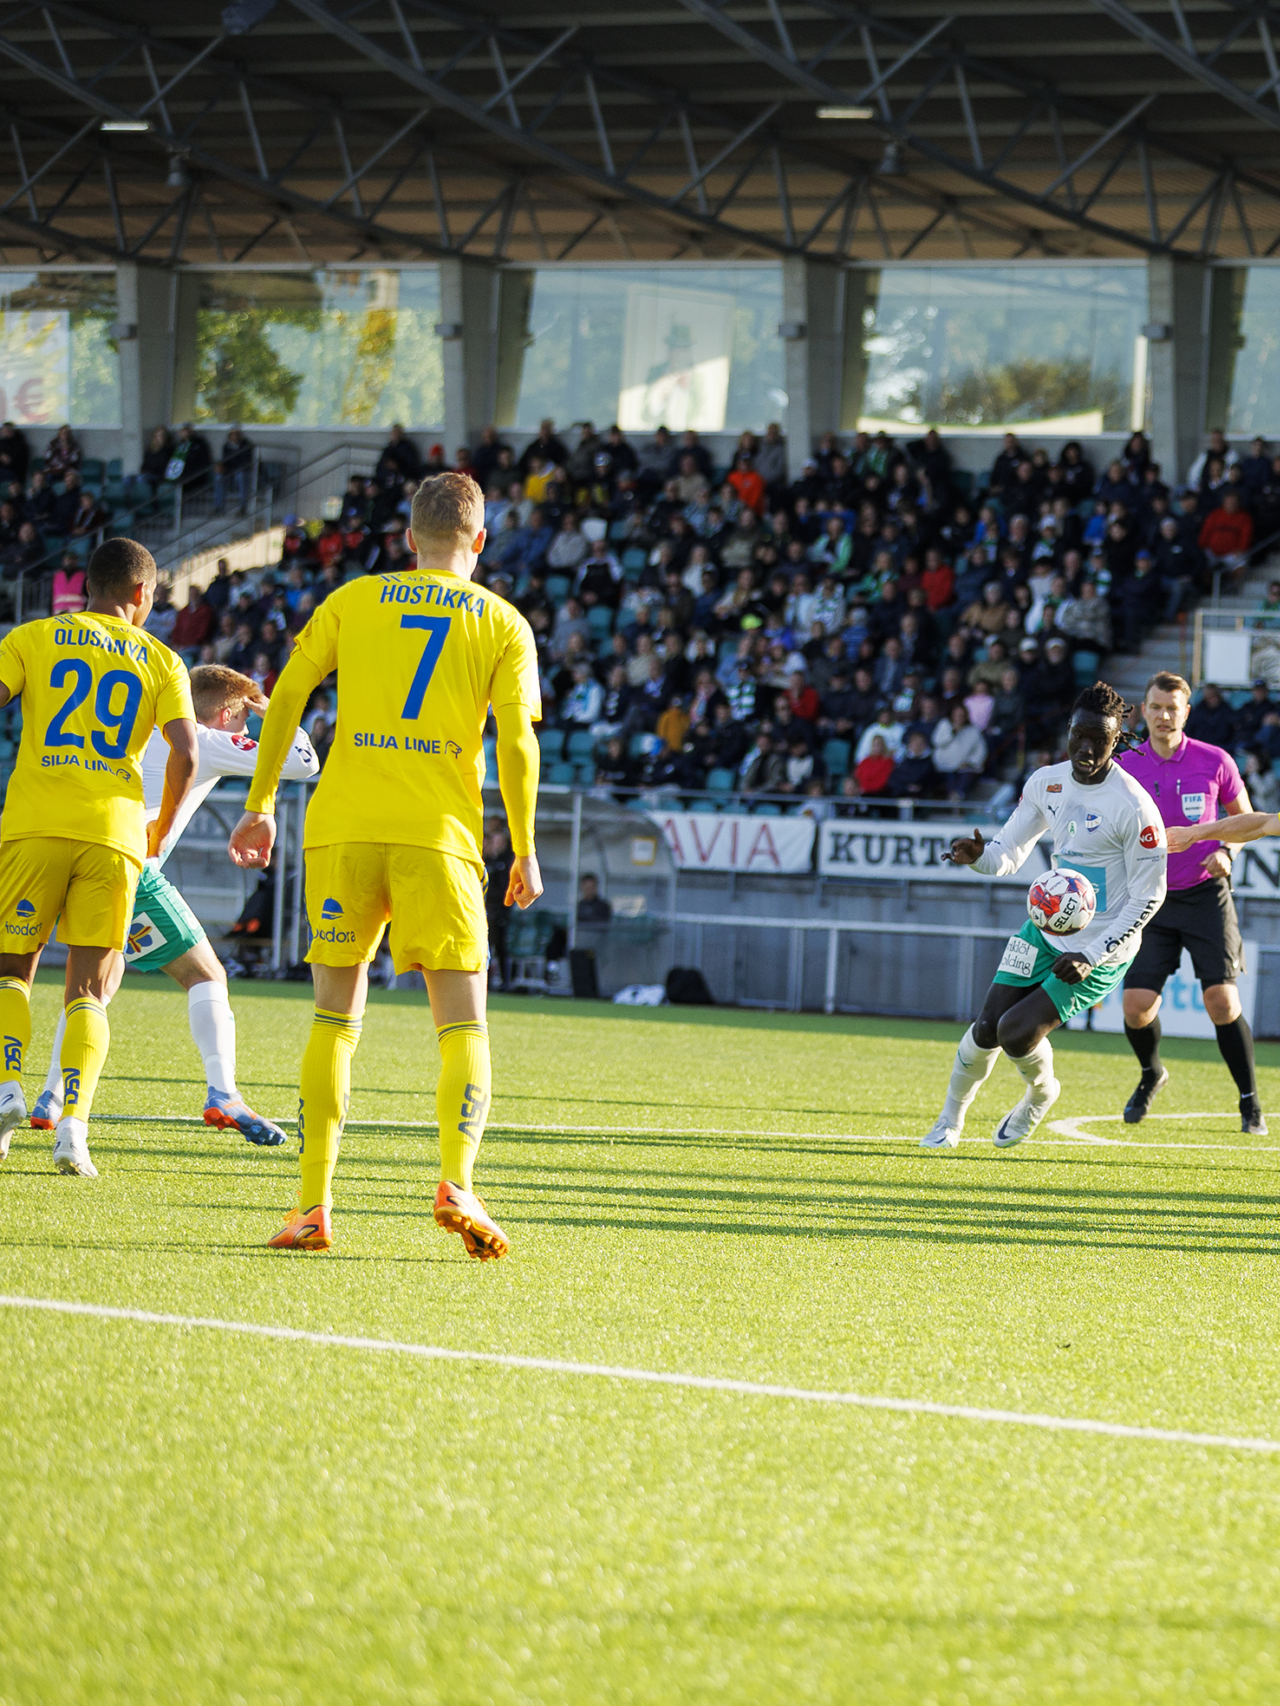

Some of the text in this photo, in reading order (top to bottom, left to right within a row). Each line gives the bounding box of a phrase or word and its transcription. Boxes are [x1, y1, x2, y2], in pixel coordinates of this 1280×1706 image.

[380, 584, 485, 618] HOSTIKKA
[54, 628, 148, 664] OLUSANYA
[400, 614, 452, 720] 7
[44, 658, 143, 760] 29
[354, 732, 441, 755] SILJA LINE
[41, 755, 80, 768] SILJA
[1054, 897, 1078, 930] SELECT
[1104, 899, 1160, 954] Ömsen
[314, 926, 356, 943] odora
[1001, 953, 1031, 976] olding
